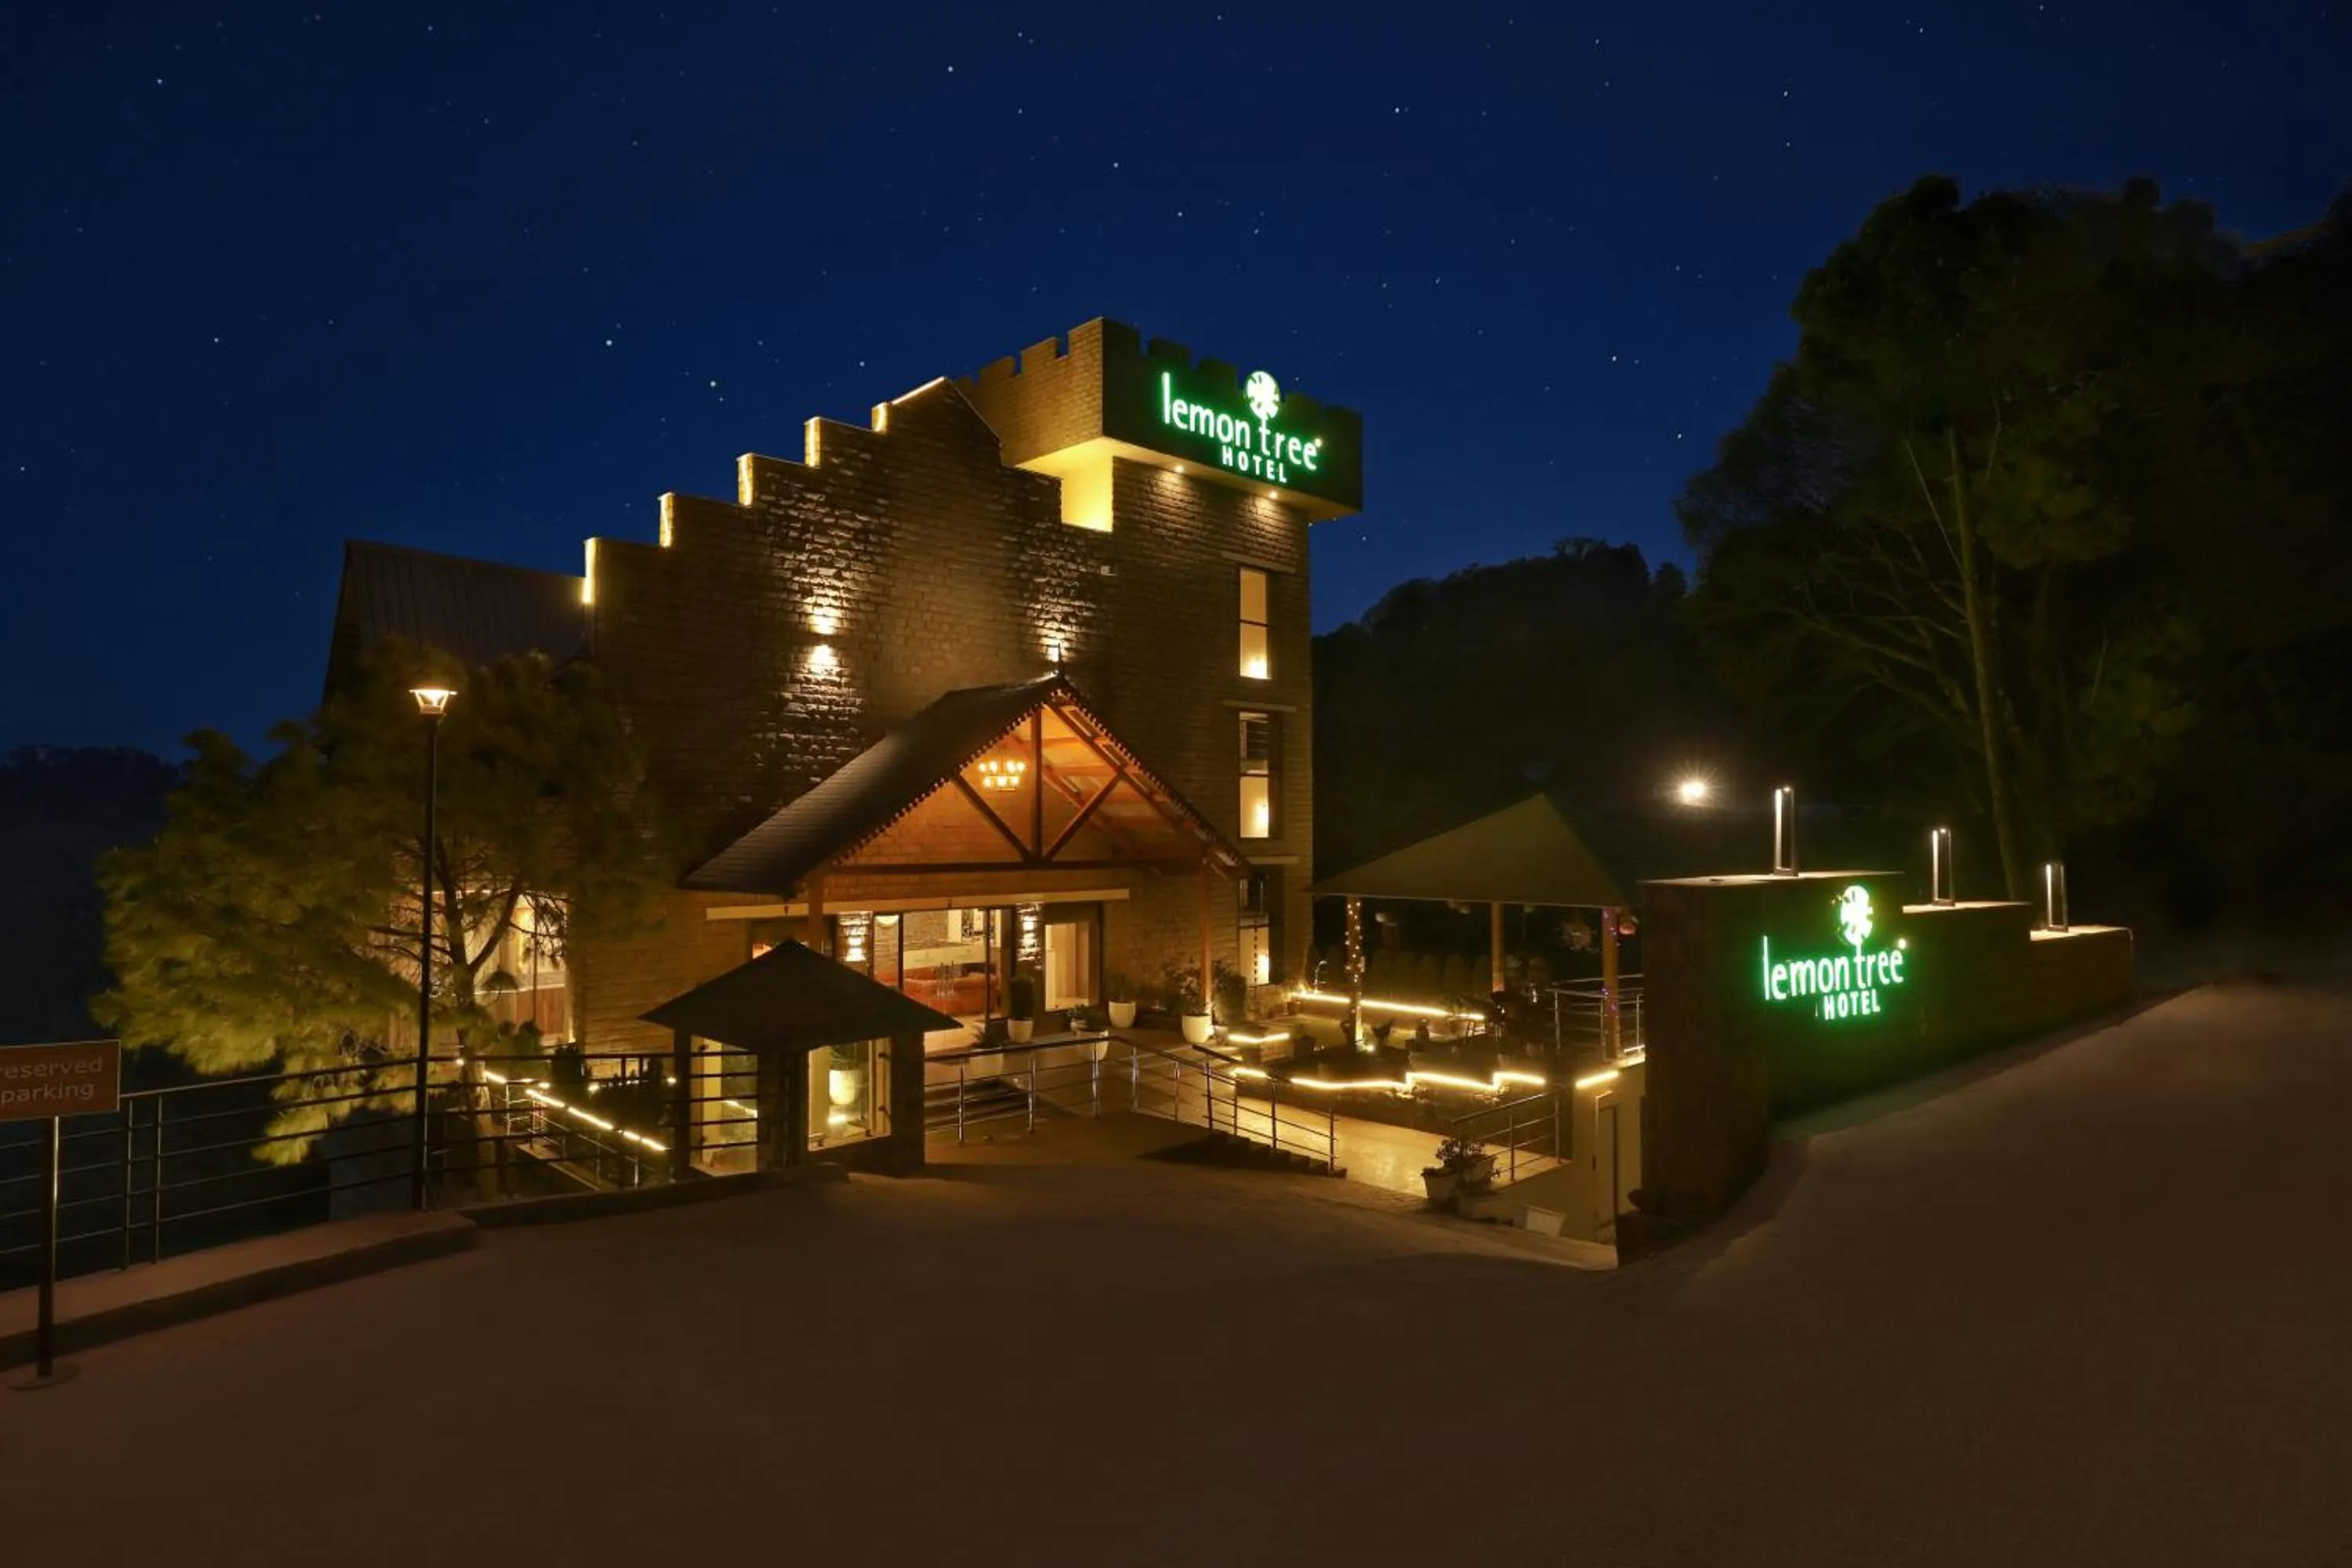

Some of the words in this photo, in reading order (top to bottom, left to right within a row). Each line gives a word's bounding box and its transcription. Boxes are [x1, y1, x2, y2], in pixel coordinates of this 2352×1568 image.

[1161, 372, 1251, 450] lemon
[1258, 417, 1318, 470] tree
[1221, 445, 1287, 483] HOTEL
[1762, 935, 1850, 1000] lemon
[1853, 944, 1904, 989] tree
[1823, 989, 1881, 1020] HOTEL
[1, 1082, 95, 1106] parking
